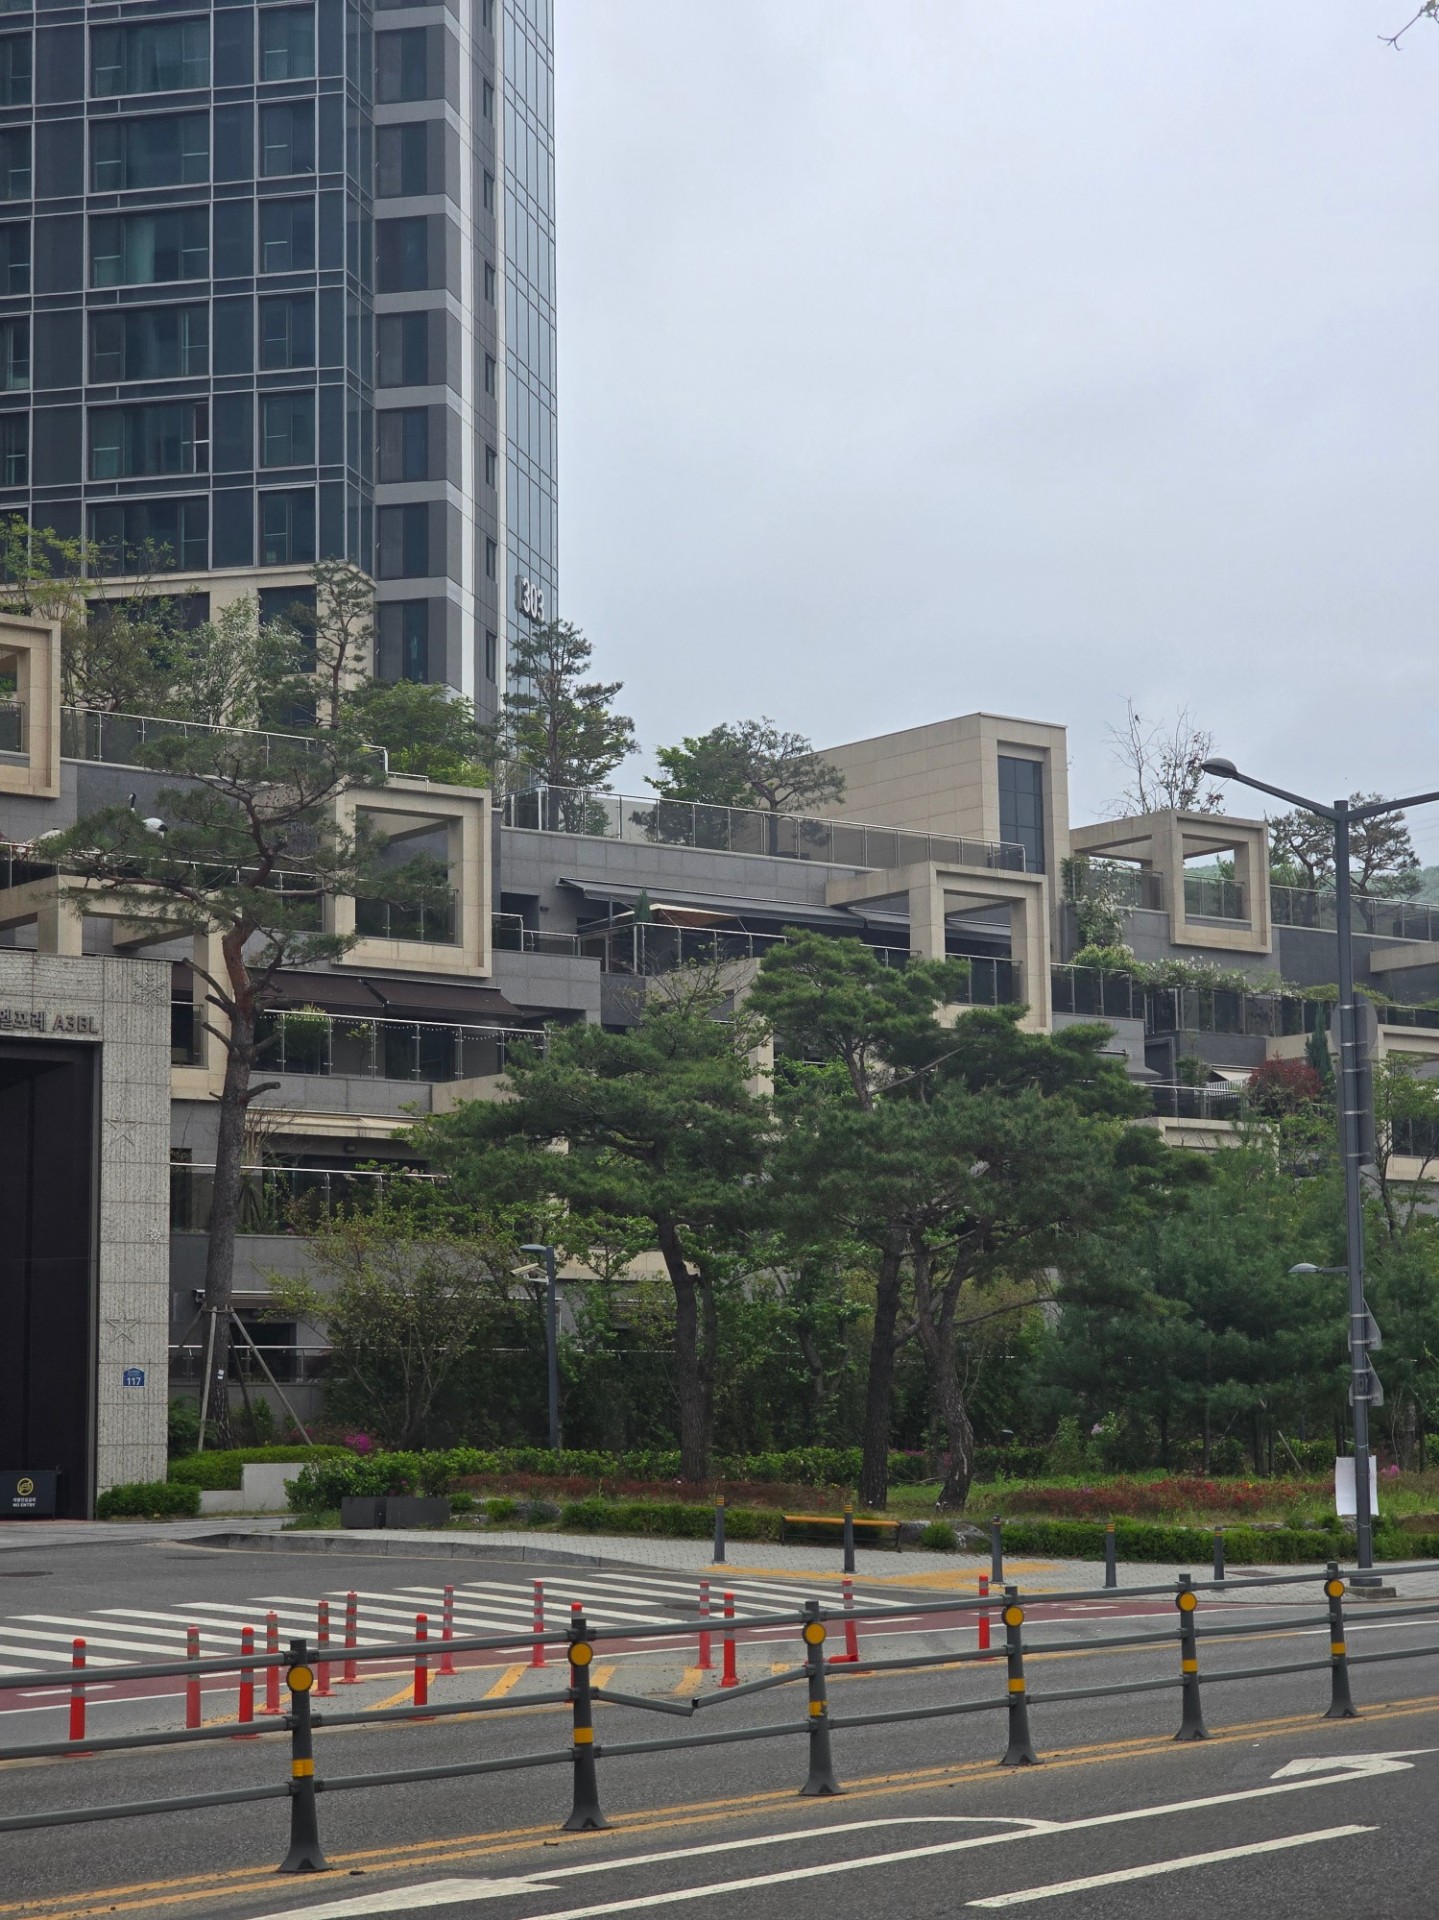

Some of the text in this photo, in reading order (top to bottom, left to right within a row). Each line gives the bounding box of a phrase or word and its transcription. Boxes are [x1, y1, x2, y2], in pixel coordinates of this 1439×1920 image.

[522, 577, 545, 623] 303
[53, 1014, 99, 1034] A3BL
[126, 1377, 141, 1386] 117
